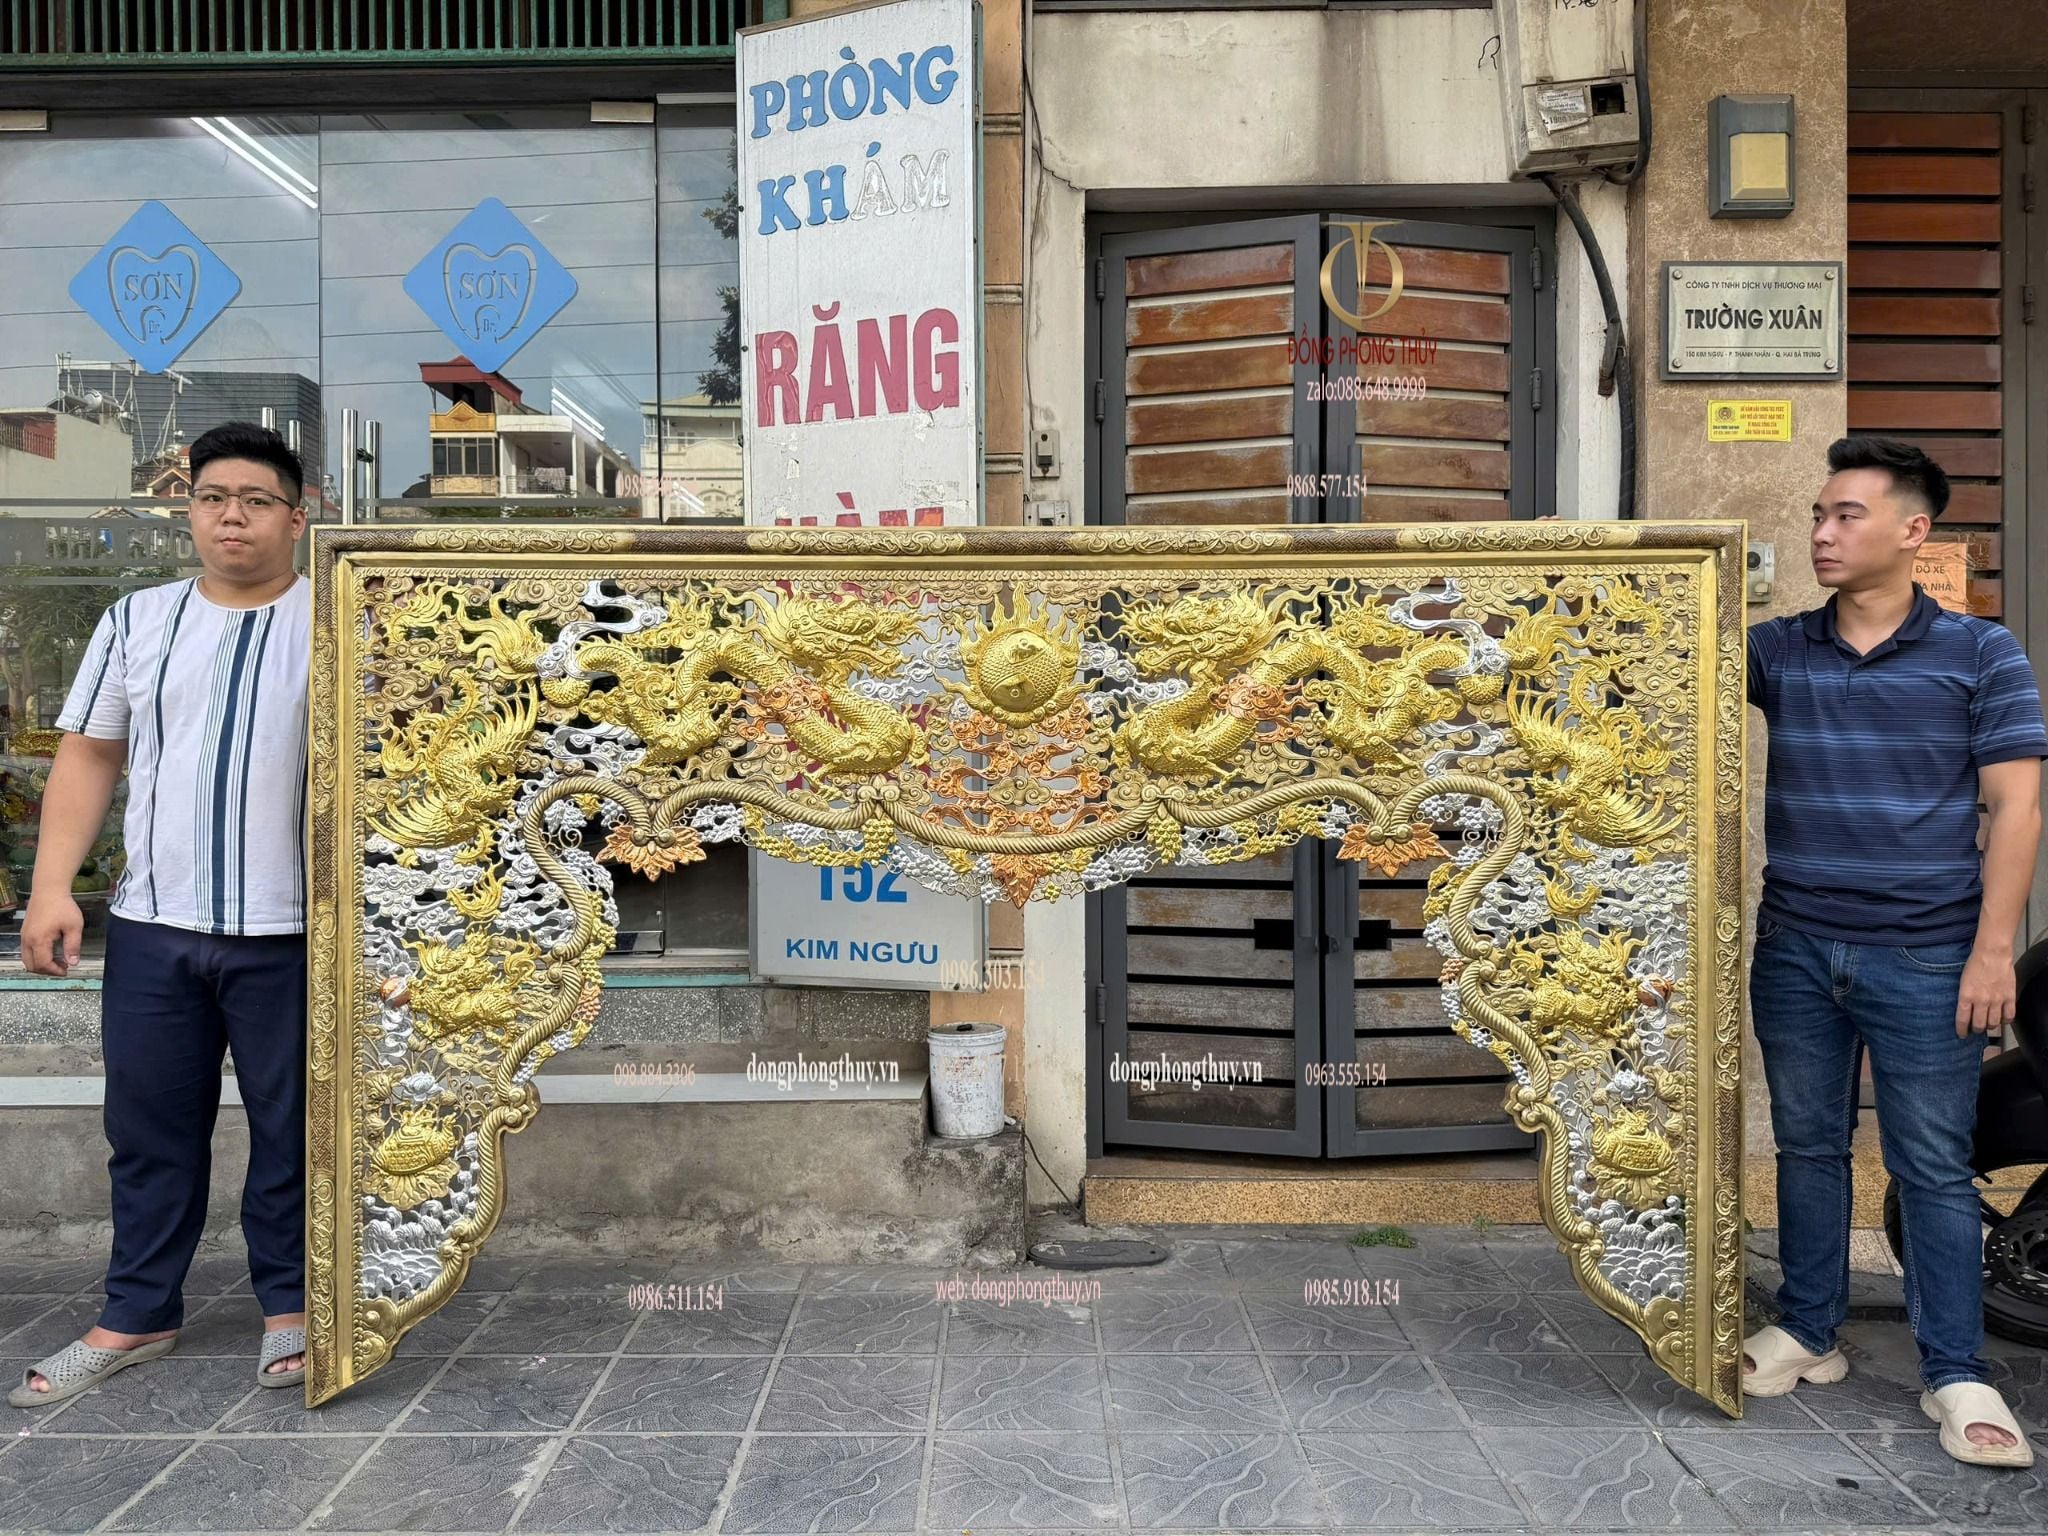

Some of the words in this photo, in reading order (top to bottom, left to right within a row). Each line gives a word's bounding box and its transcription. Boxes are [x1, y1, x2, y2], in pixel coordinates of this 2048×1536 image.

[749, 44, 958, 139] PHÒNG
[757, 141, 951, 236] KHÁM
[124, 271, 183, 301] SƠN
[459, 270, 519, 300] SƠN
[1685, 280, 1710, 289] CÔNG
[1711, 281, 1720, 289] TY
[1721, 281, 1740, 289] TNHH
[1741, 280, 1760, 291] DỊCH
[1807, 281, 1822, 291] MẠI
[1685, 302, 1763, 329] TRƯỜNG
[1768, 304, 1822, 329] XUÂN
[755, 301, 960, 428] RĂNG
[1933, 565, 1945, 575] XE
[786, 938, 839, 961] KIM
[850, 941, 939, 965] NGƯU
